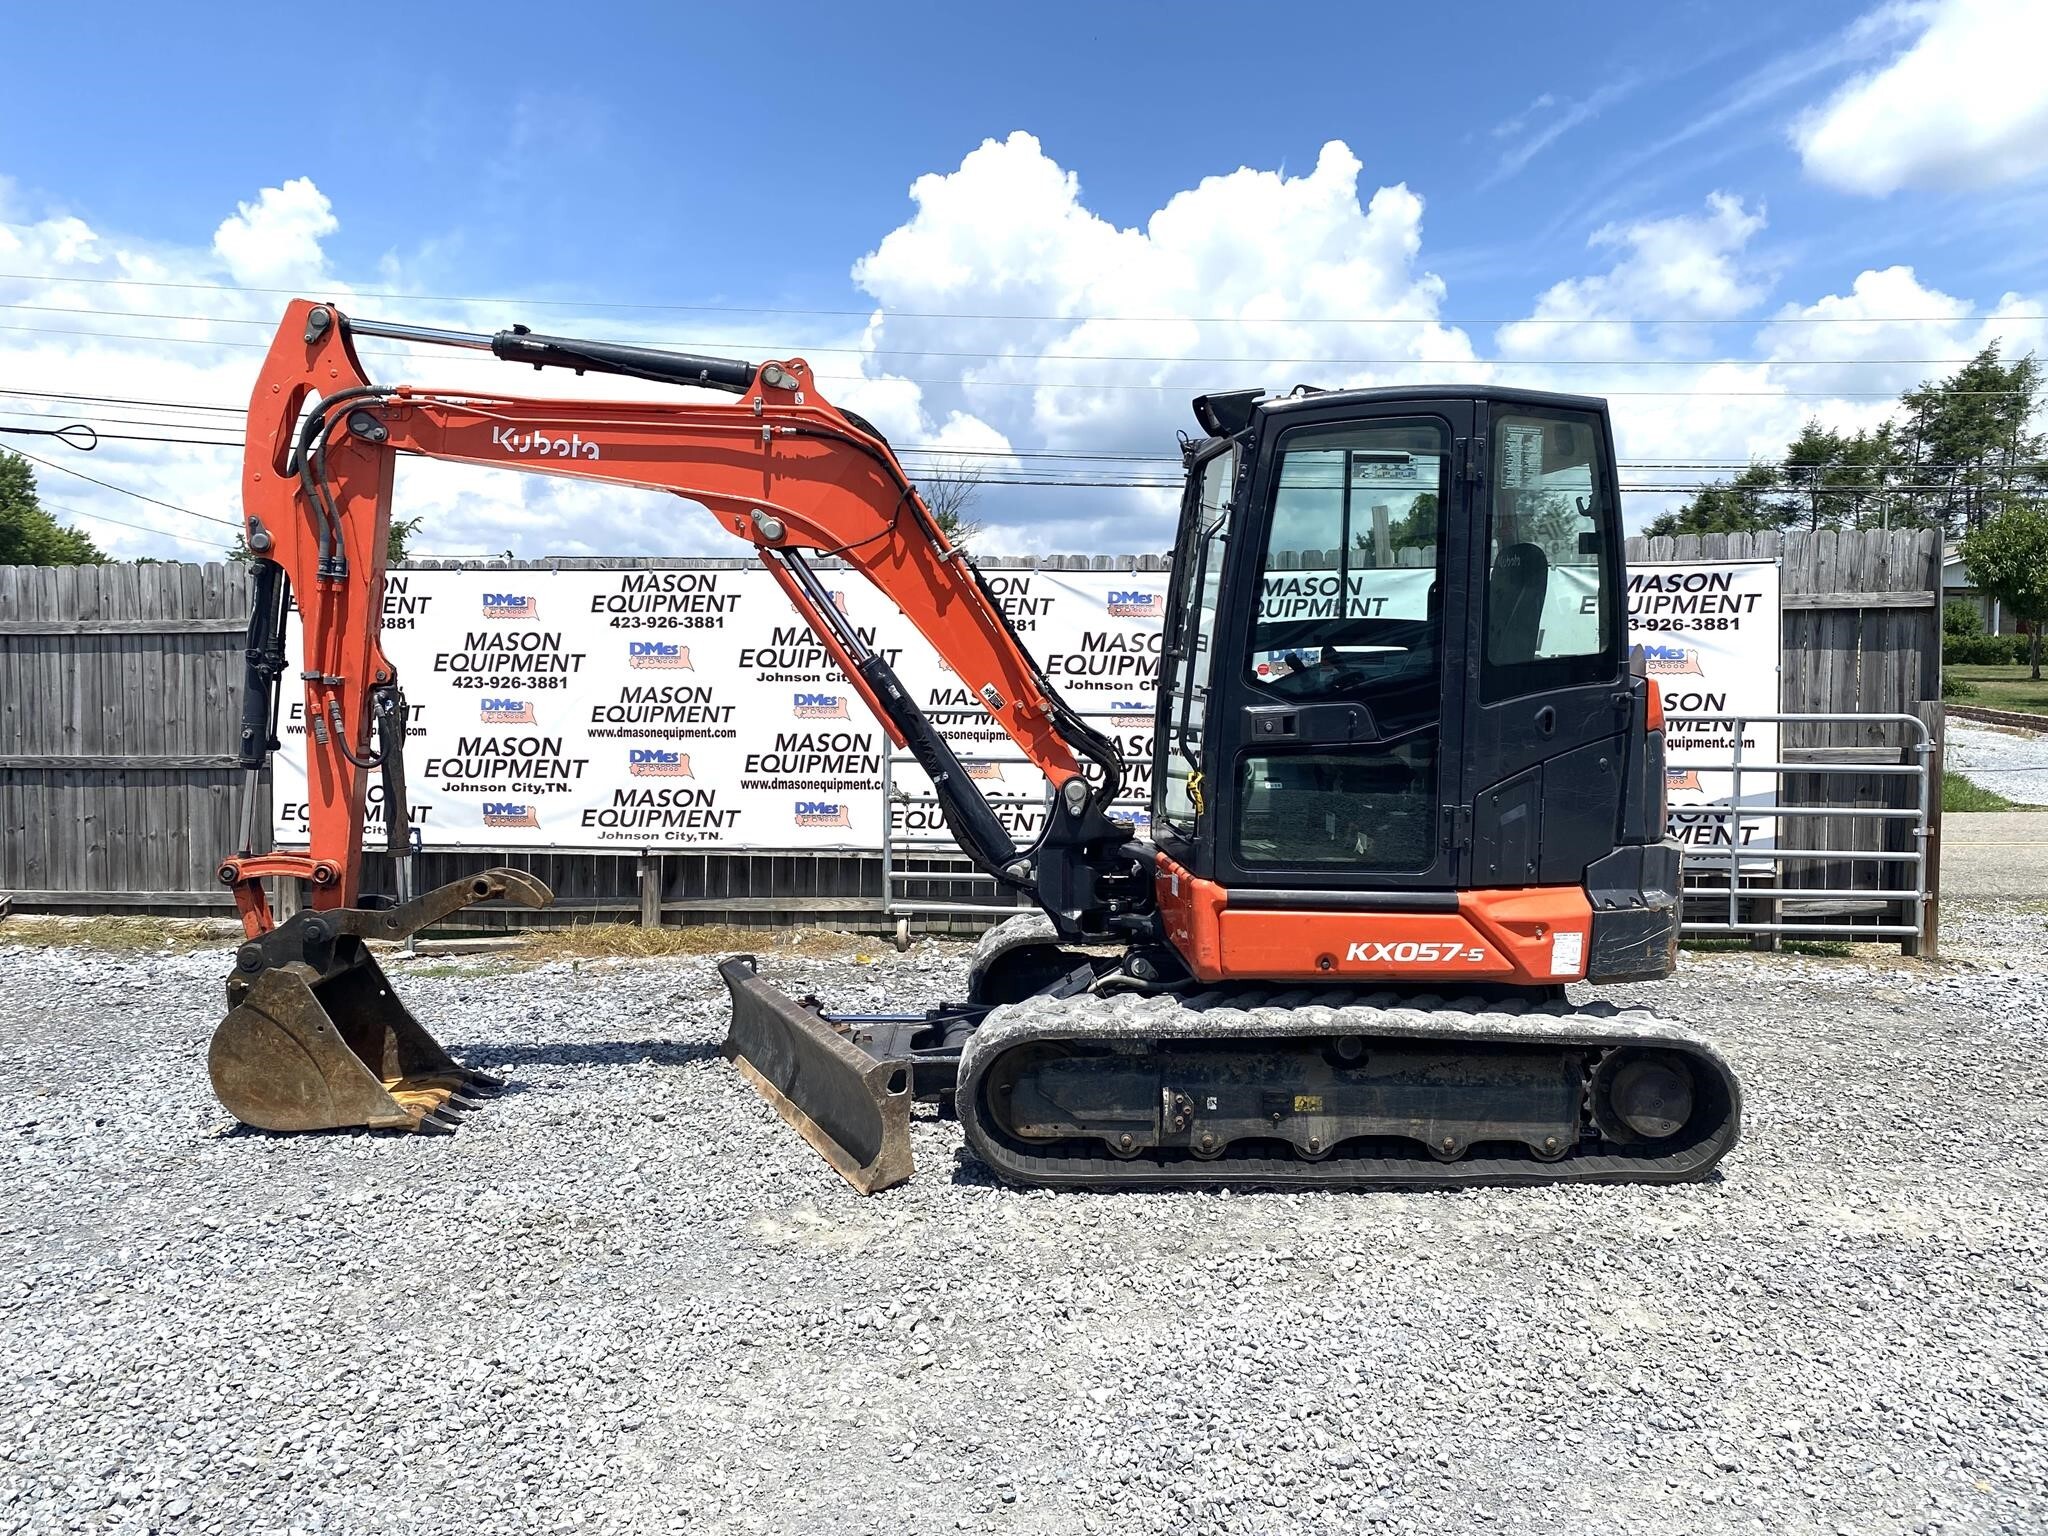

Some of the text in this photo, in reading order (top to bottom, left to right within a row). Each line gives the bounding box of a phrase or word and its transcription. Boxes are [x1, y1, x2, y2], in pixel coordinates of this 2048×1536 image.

[492, 426, 600, 460] Kubota
[622, 575, 716, 592] MASON
[1264, 577, 1362, 597] MASON
[591, 595, 741, 612] EQUIPMENT
[610, 617, 723, 628] 423-926-3881
[1628, 618, 1740, 631] 3-926-3881
[465, 632, 561, 651] MASON
[771, 627, 876, 646] MAN
[1081, 632, 1162, 653] MASO
[434, 654, 586, 672] EQUIPMENT
[739, 649, 902, 668] EQUIPT
[1046, 655, 1159, 676] EQUIPM
[453, 677, 566, 688] 423-926-3881
[757, 673, 820, 681] Johnson
[1065, 680, 1132, 690] Johnson
[621, 687, 712, 703] MASON
[930, 688, 981, 705] MAS
[1664, 692, 1727, 712] SON
[592, 706, 735, 722] EQUIPMENT
[588, 727, 736, 740] www.dmasonequipment.com
[458, 737, 562, 756] MASON
[775, 734, 871, 752] MASON
[424, 759, 589, 778] EQUIPMENT
[744, 754, 884, 773] EQUIPMEN
[442, 783, 571, 794] Johnson City,TN.
[740, 778, 897, 792] www.dmasonequipment.c
[613, 789, 715, 807] MASON
[582, 809, 741, 827] EQUIPMENT
[891, 811, 1047, 832] EQUENT
[665, 832, 723, 842] City,TN.
